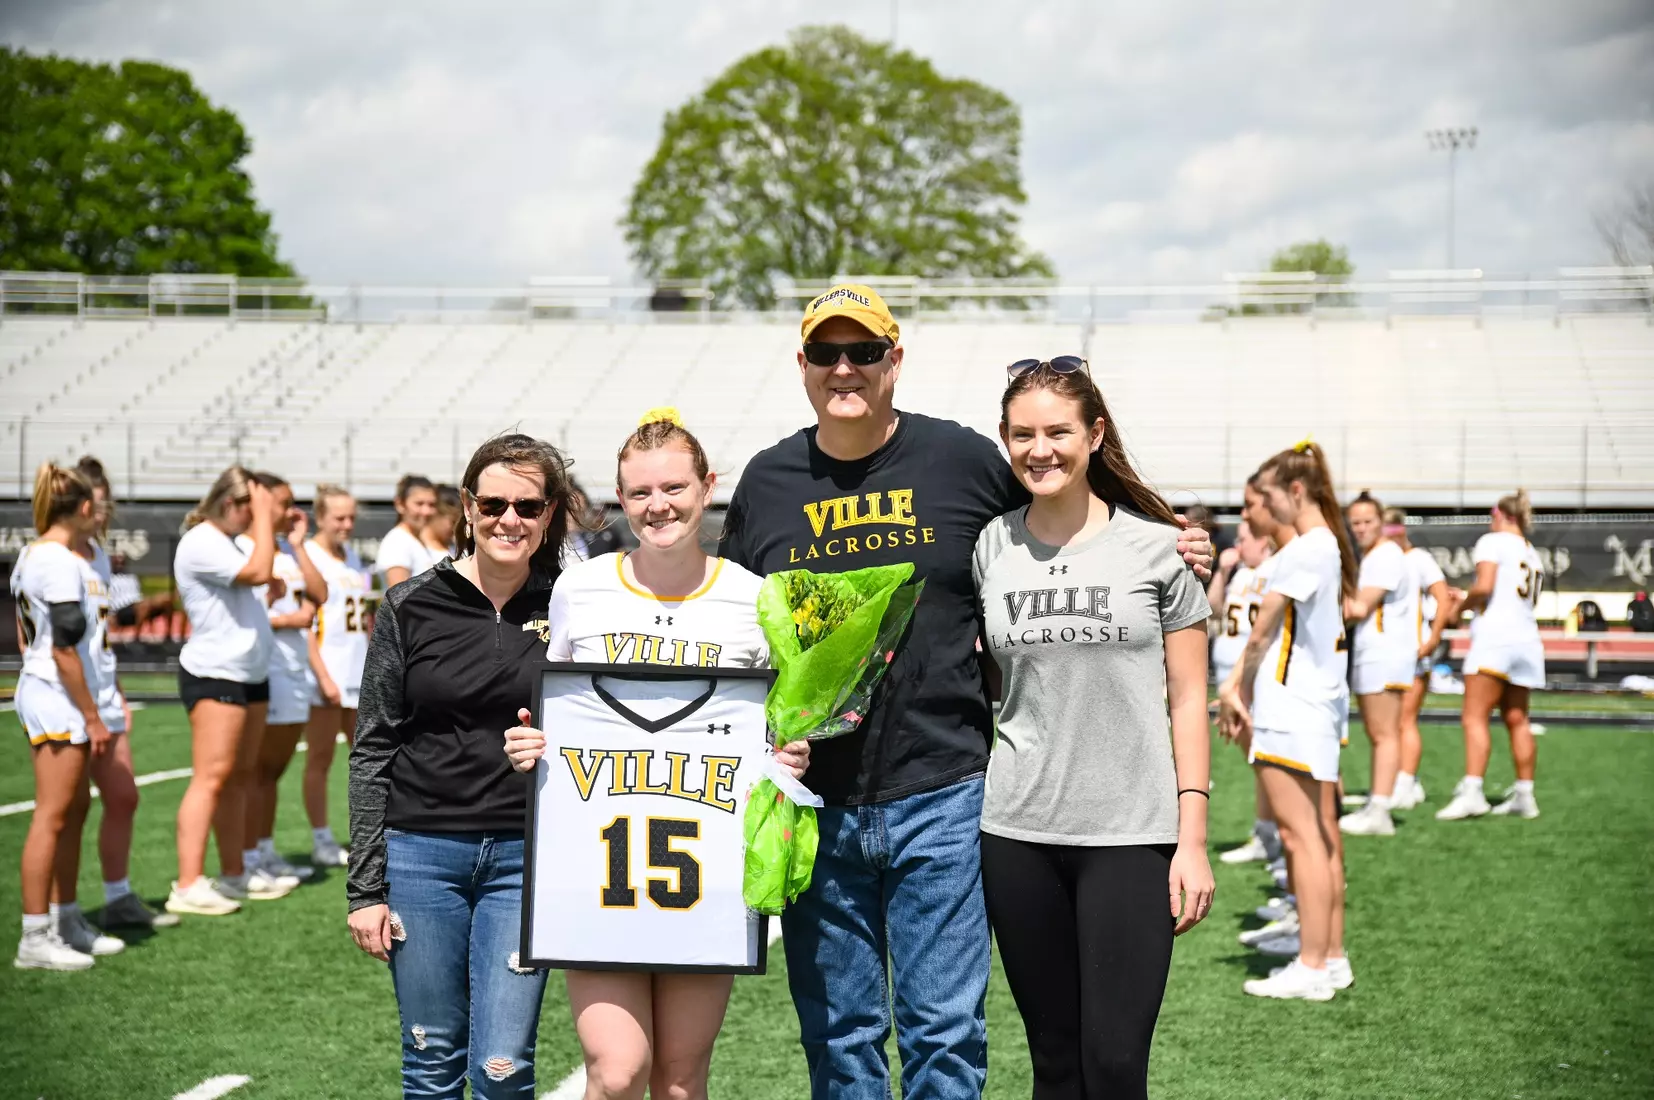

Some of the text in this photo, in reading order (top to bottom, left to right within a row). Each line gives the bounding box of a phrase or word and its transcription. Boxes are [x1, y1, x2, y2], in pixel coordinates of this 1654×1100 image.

[812, 289, 870, 313] MILLERSVILLE
[803, 489, 917, 538] VILLE
[789, 528, 936, 563] LACROSSE
[1003, 586, 1112, 625] VILLE
[601, 632, 722, 667] VILLE
[991, 626, 1129, 649] LACROSSE
[560, 747, 742, 815] VILLE
[600, 815, 703, 912] 15
